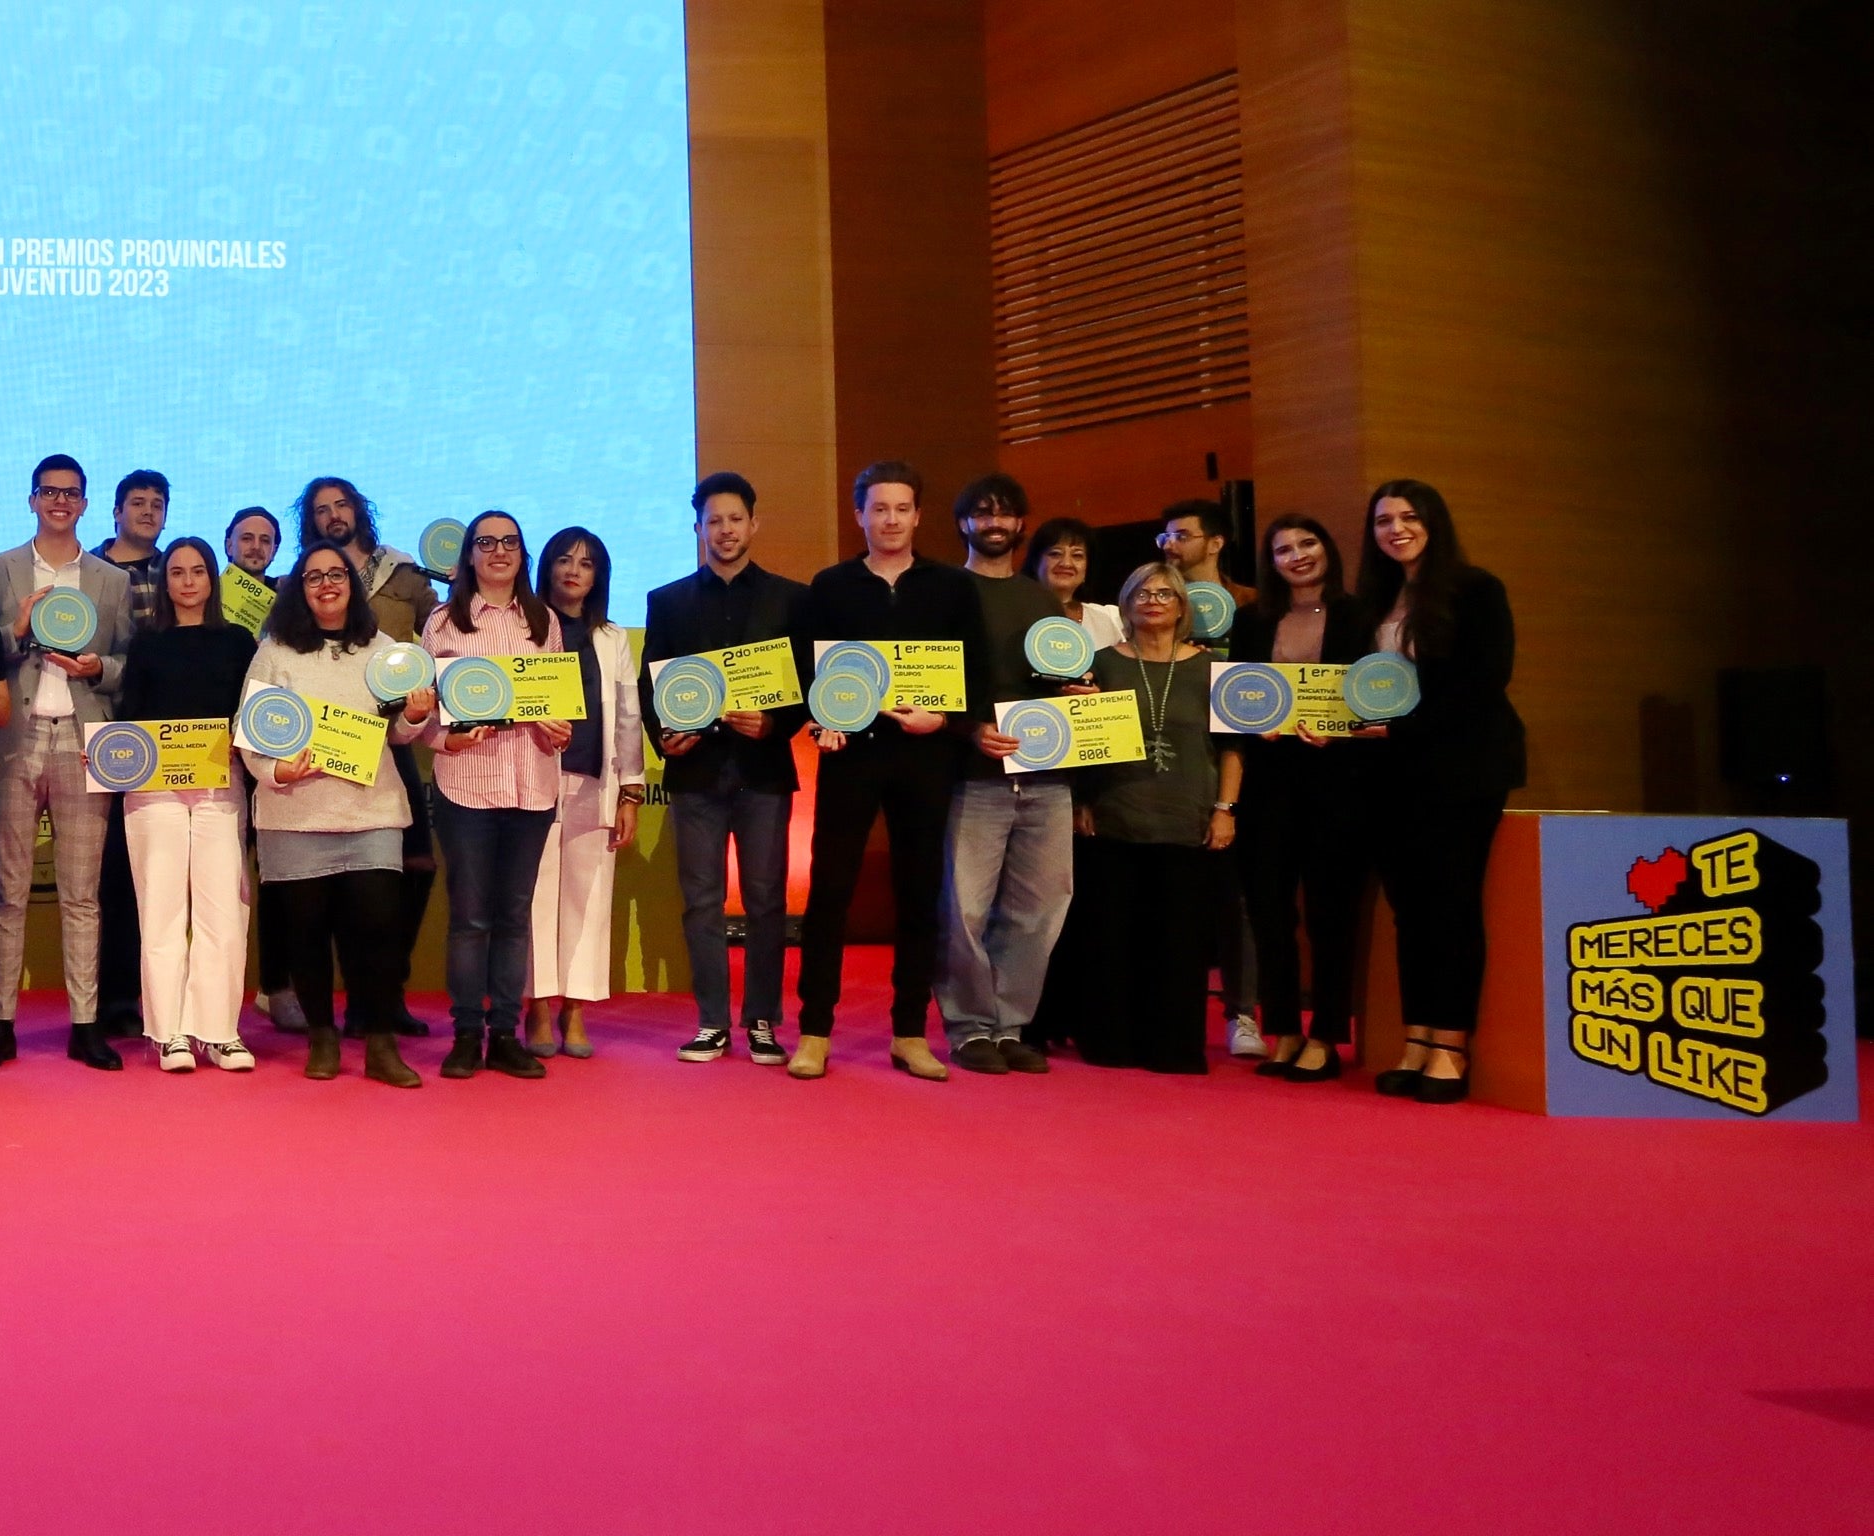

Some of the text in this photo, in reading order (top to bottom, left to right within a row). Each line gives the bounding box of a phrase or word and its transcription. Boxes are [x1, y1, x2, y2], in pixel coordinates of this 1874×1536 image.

[11, 238, 115, 268] PREMIOS
[121, 241, 286, 269] PROVINCIALES
[108, 269, 169, 297] 2023
[440, 539, 456, 551] TOP
[54, 610, 76, 622] TOP
[753, 642, 788, 654] PREMIO
[925, 645, 960, 653] PREMIO
[1048, 640, 1072, 650] TOP
[542, 656, 576, 664] PREMIO
[727, 665, 760, 675] INICIATIVA
[728, 670, 773, 682] EMPRESARIAL
[465, 685, 489, 694] TOP
[1237, 690, 1266, 701] TOP
[675, 691, 698, 702] TOP
[833, 692, 857, 701] TOP
[1100, 695, 1133, 704] PREMIO
[517, 704, 551, 717] 300€
[266, 712, 290, 725] TOP
[351, 714, 385, 729] PREMIO
[1073, 717, 1102, 725] TRABAJO
[192, 723, 226, 731] PREMIO
[318, 723, 362, 741] SOCIAL MEDIA
[1022, 726, 1048, 737] TOP
[1074, 724, 1104, 732] SOLISTAS
[110, 749, 134, 759] TOP
[1078, 746, 1112, 761] 800€
[163, 773, 196, 785] 700€
[1701, 841, 1751, 888] TE
[1579, 915, 1753, 960] MERECES
[1580, 978, 1756, 1030] MÁS QUE
[1582, 1022, 1758, 1104] UN LIKE
